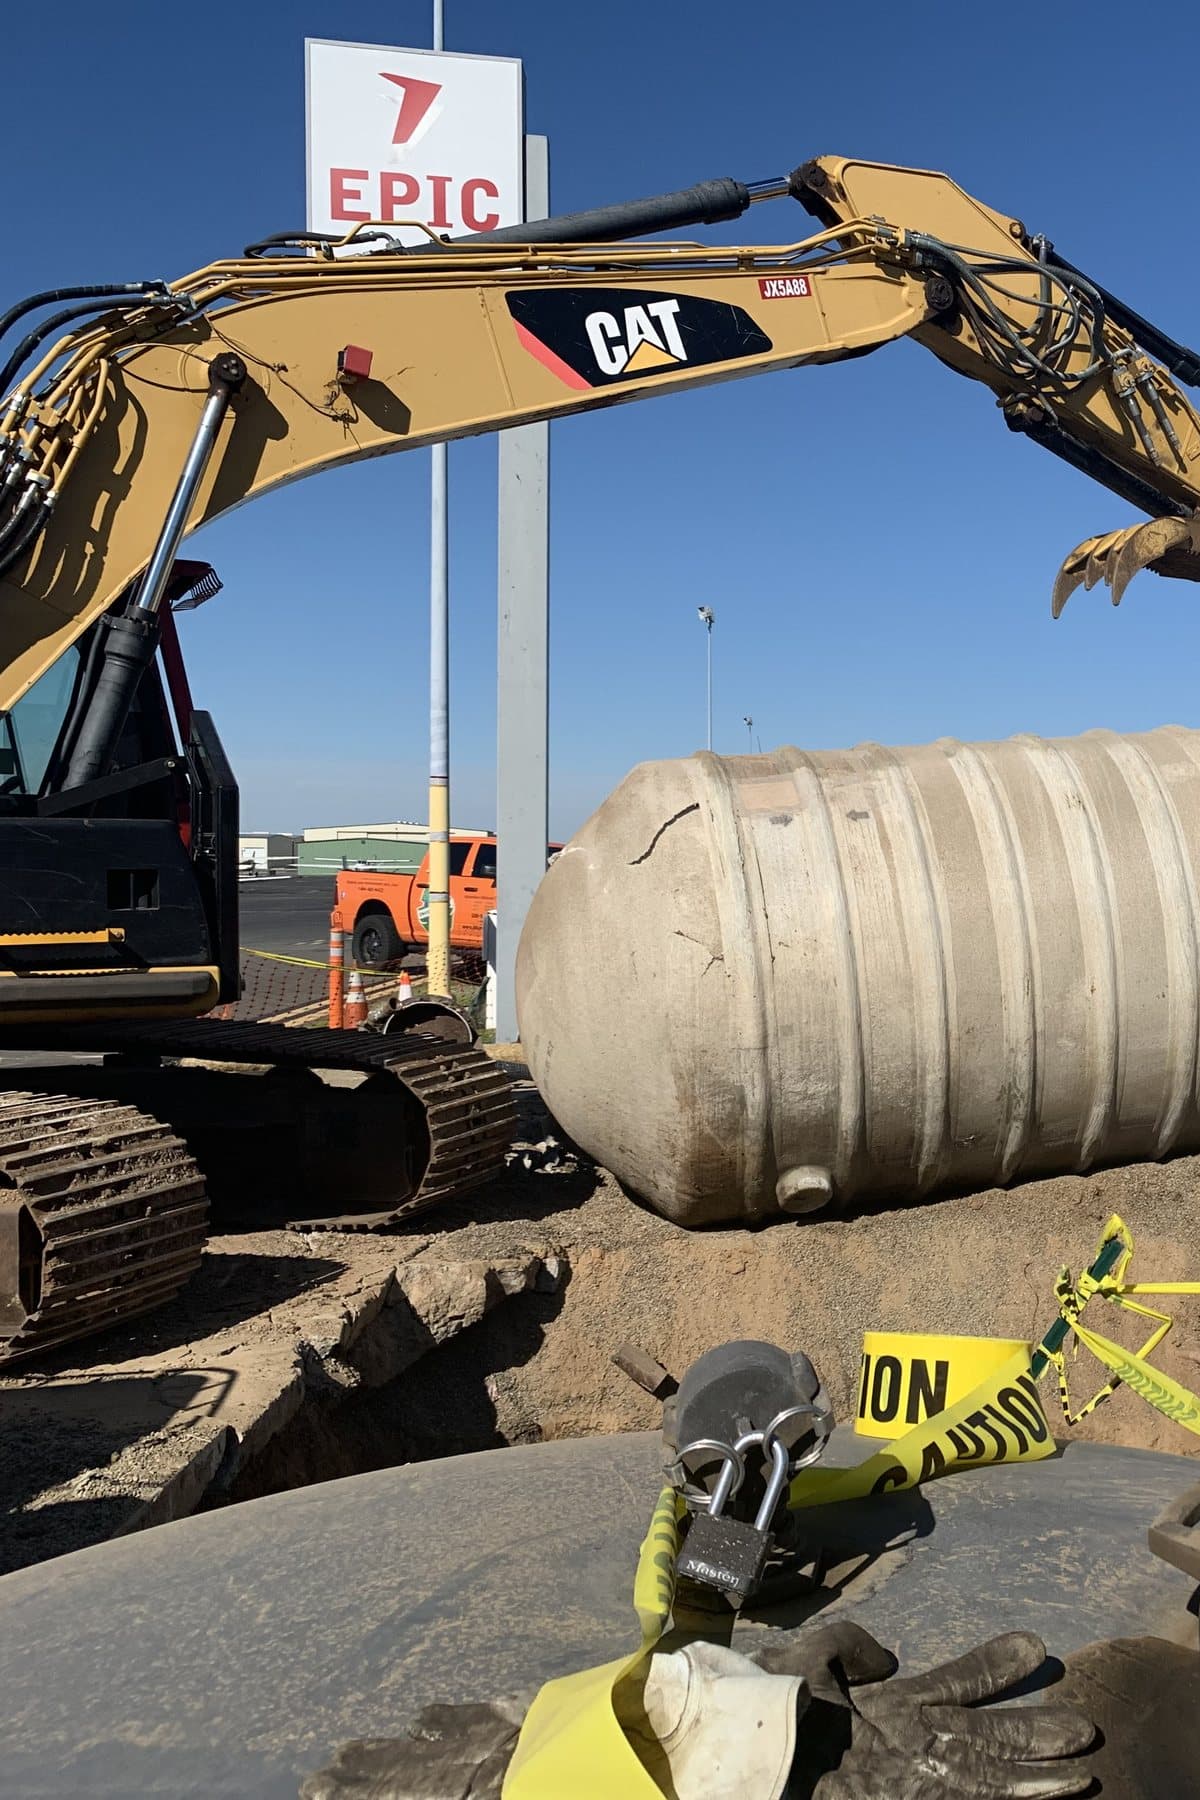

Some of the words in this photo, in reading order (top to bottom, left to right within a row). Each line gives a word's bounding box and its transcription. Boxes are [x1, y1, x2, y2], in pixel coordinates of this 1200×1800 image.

[329, 167, 500, 232] EPIC
[764, 278, 808, 298] JX5A88
[584, 298, 688, 375] CAT
